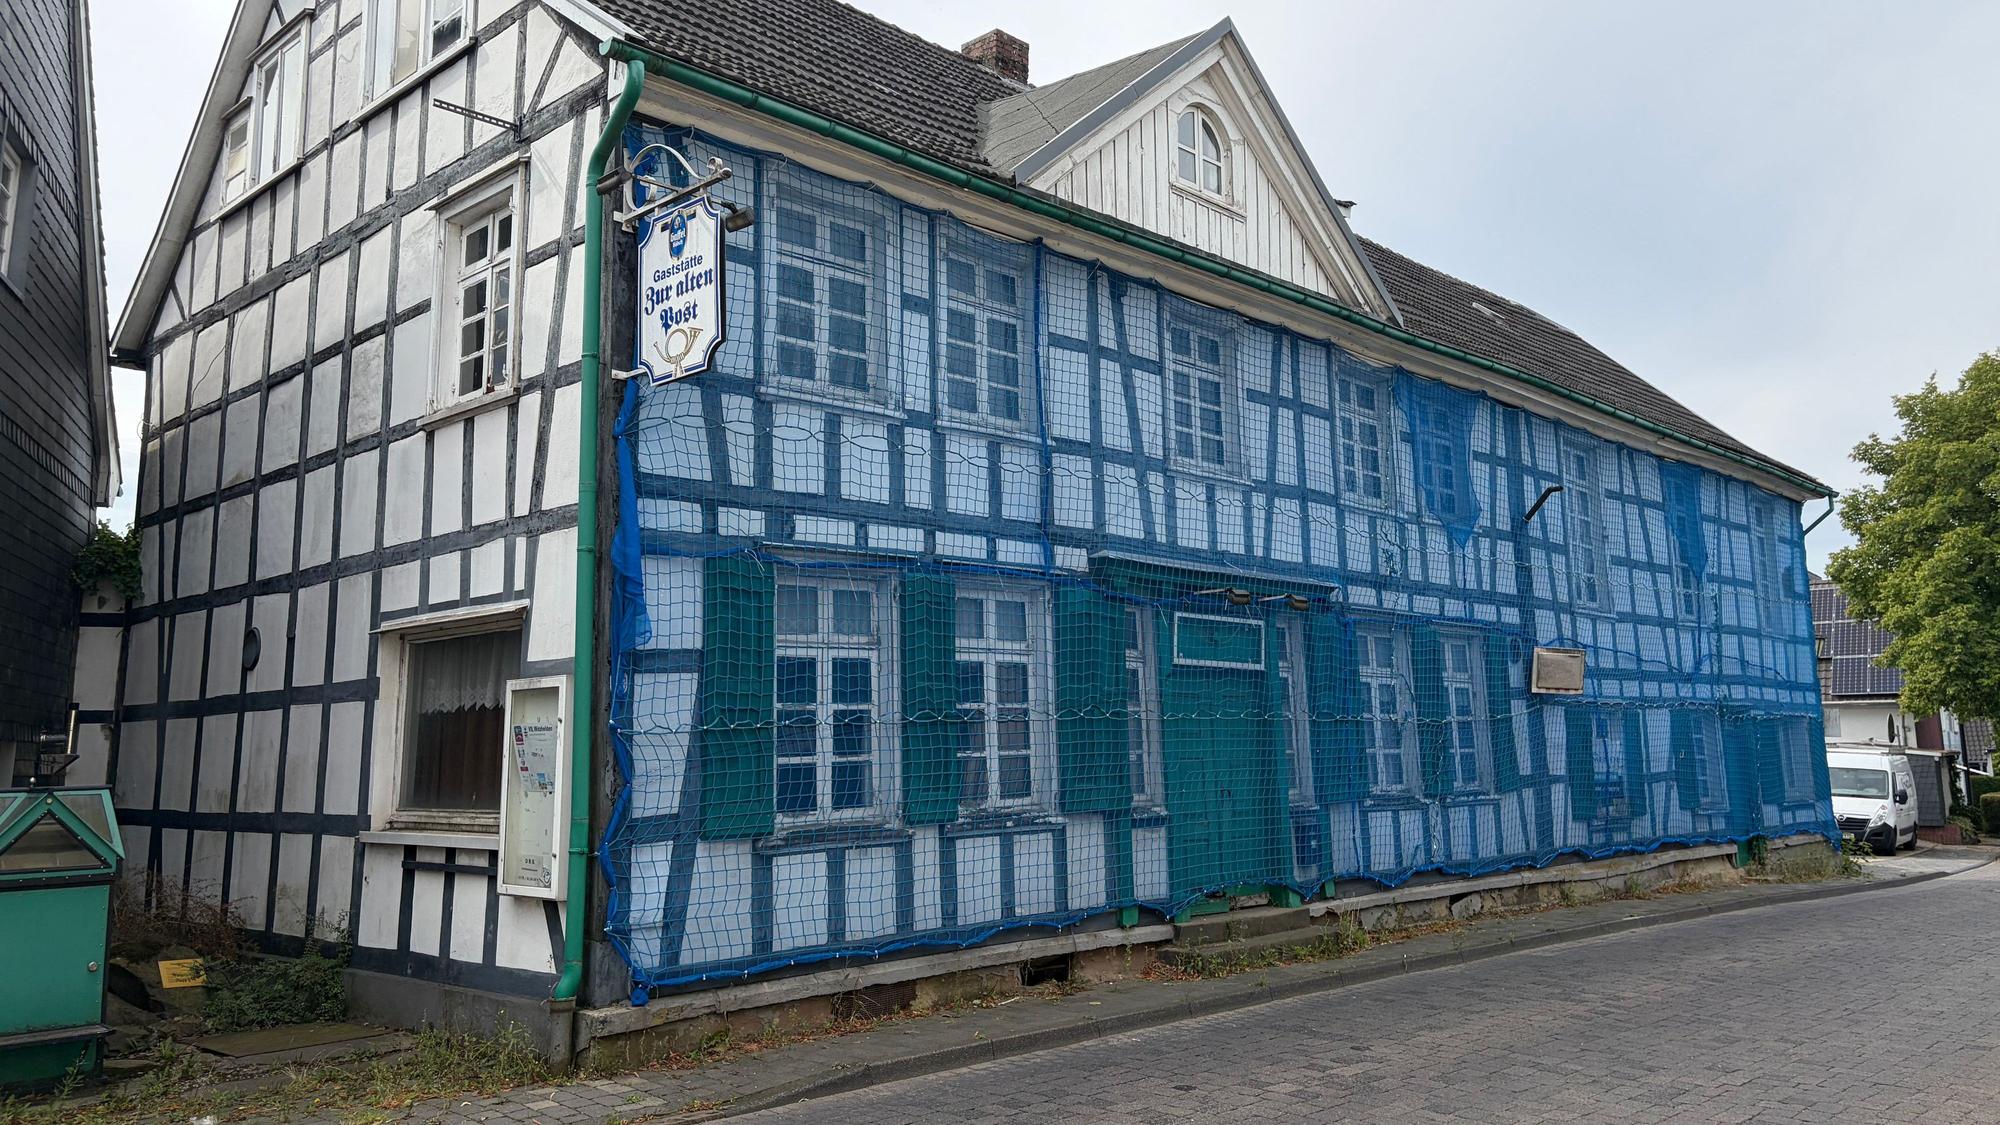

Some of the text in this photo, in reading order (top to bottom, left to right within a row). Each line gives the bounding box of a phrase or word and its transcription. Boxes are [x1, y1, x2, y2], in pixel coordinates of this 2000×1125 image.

[653, 255, 703, 283] Gaststätte
[644, 268, 714, 316] Zur alten
[660, 298, 699, 336] Post
